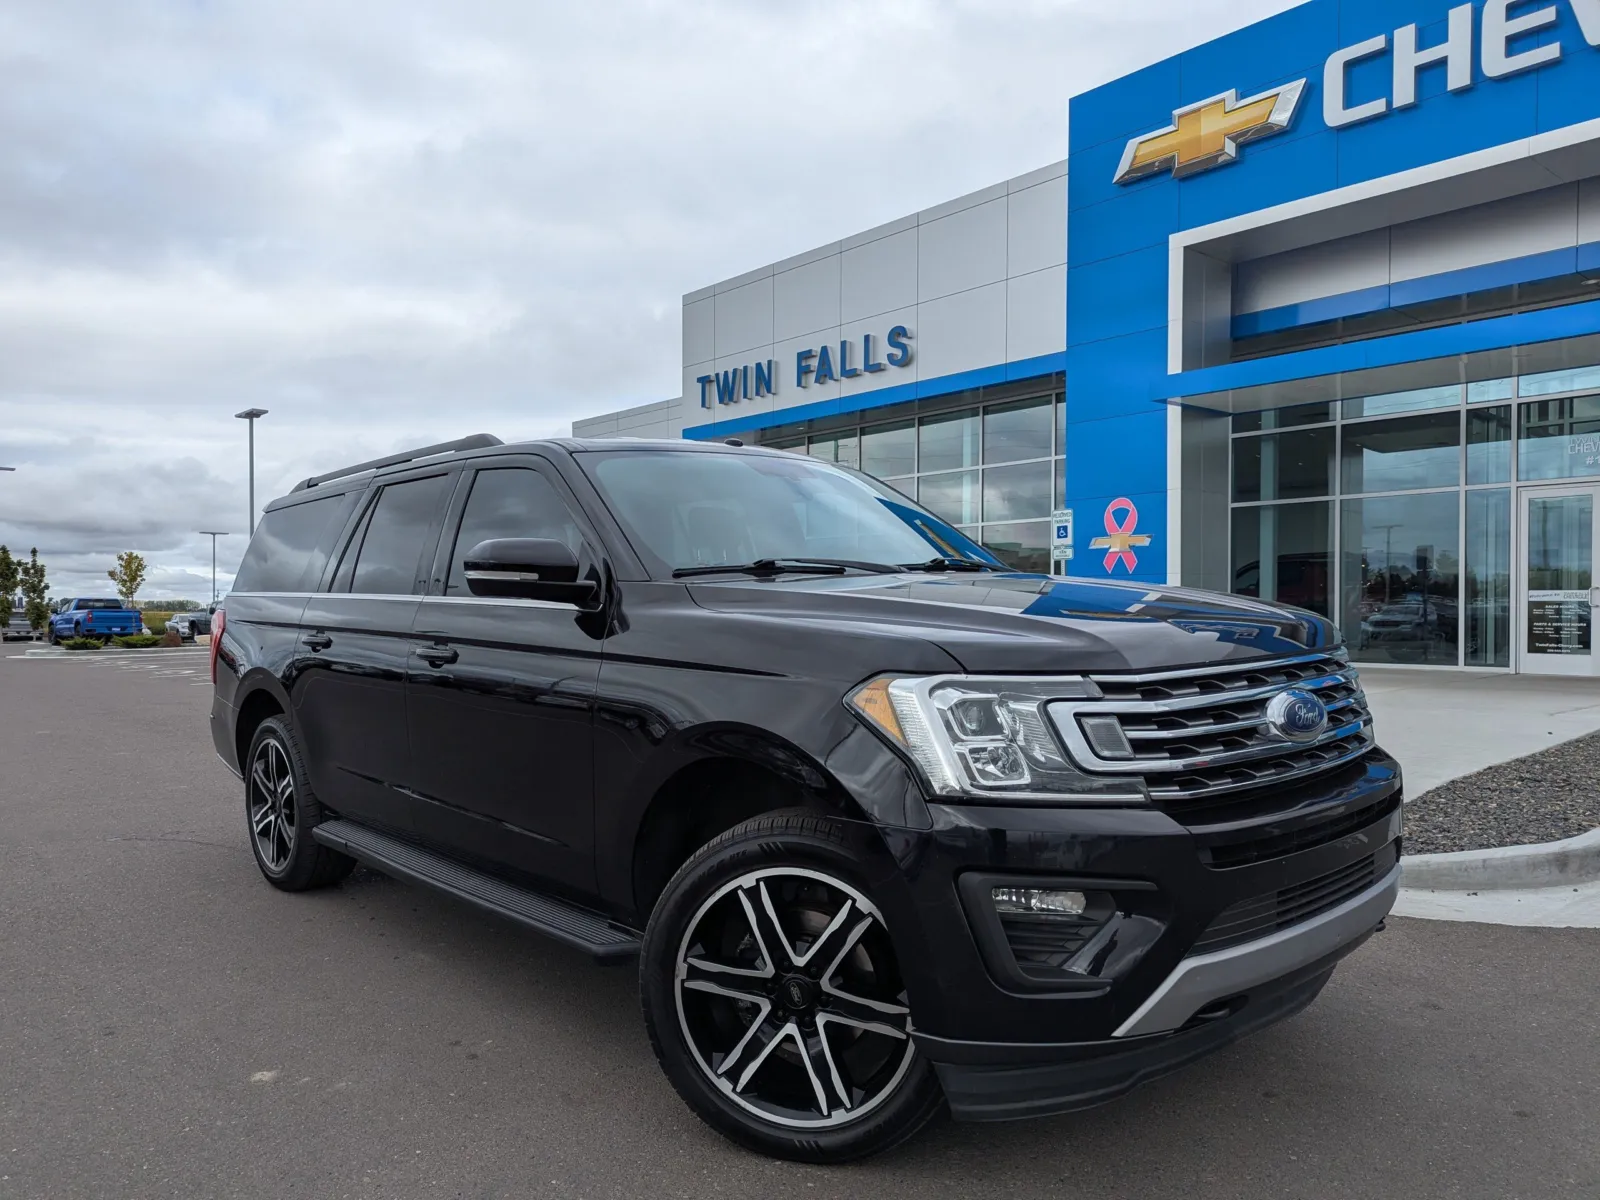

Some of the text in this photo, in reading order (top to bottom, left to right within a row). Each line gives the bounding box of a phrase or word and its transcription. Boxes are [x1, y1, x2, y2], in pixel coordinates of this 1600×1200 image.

[696, 325, 913, 409] TWIN FALLS
[1296, 703, 1320, 724] Ford
